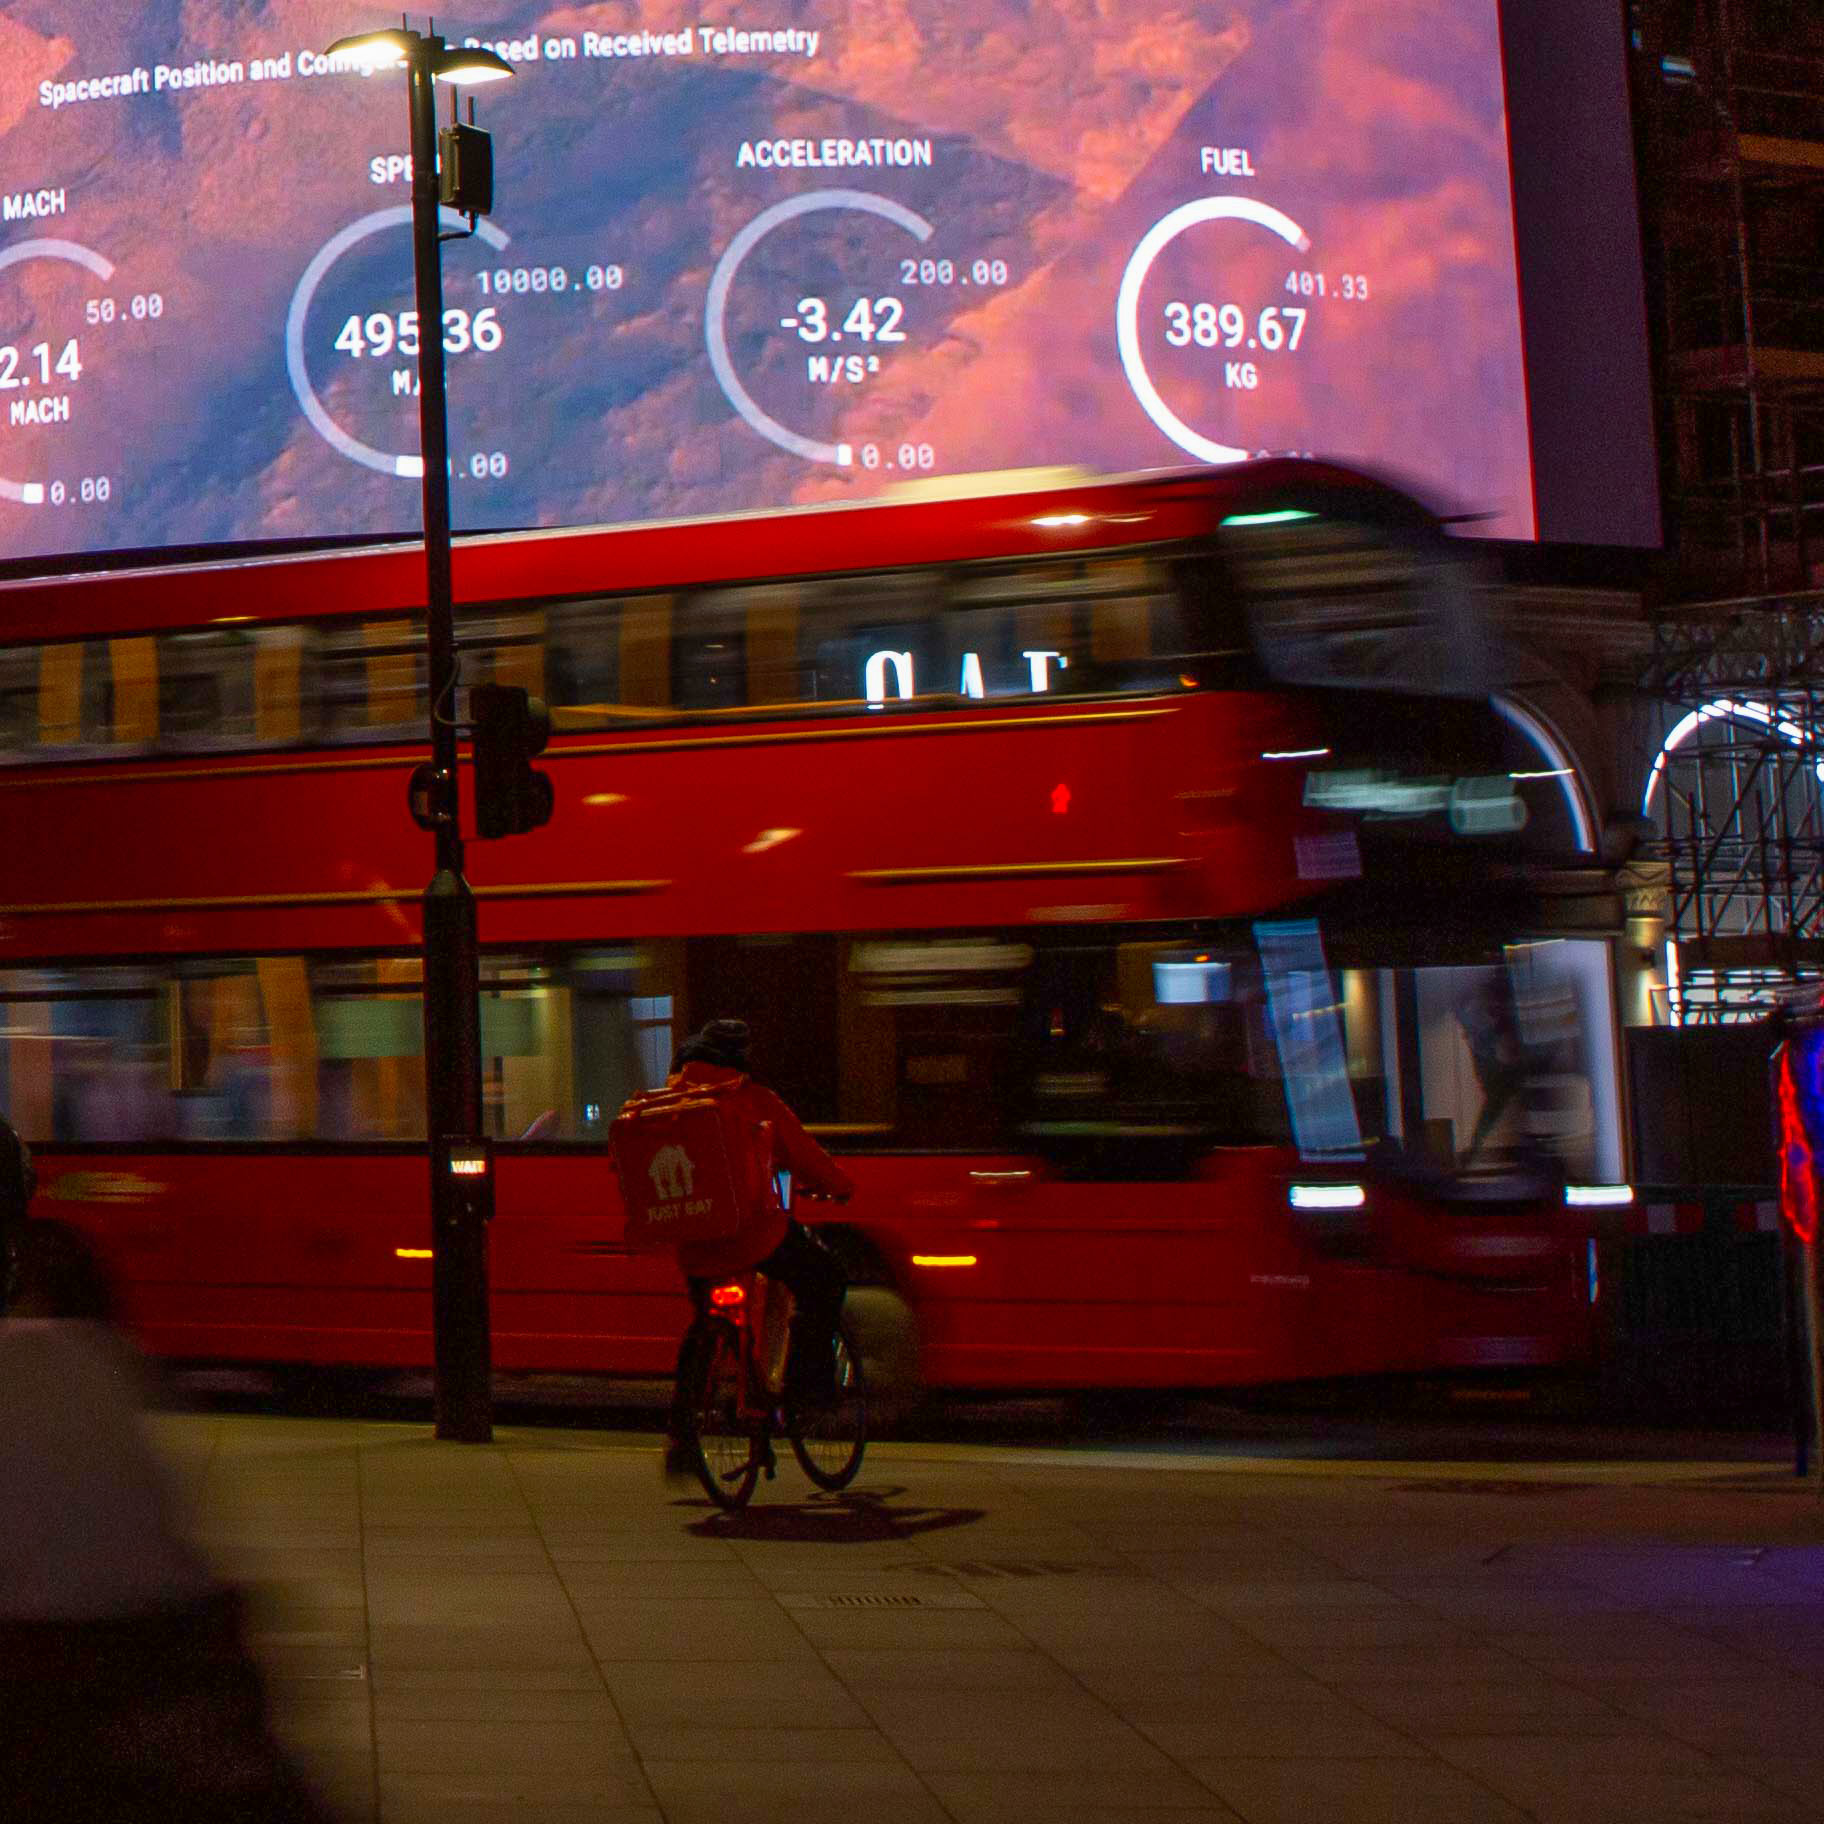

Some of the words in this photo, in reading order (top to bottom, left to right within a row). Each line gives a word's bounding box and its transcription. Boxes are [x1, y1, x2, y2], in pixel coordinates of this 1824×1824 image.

[544, 37, 576, 59] on
[582, 28, 693, 58] Received
[698, 26, 820, 58] Telemetry
[39, 67, 150, 109] Spacecraft
[154, 60, 243, 91] Position
[250, 52, 291, 81] and
[737, 139, 932, 168] ACCELERATION
[1200, 146, 1255, 176] FUEL
[2, 189, 66, 221] MACH
[476, 265, 624, 294] 10000.00
[900, 258, 1009, 286] 200.00
[1285, 271, 1369, 300] 401.33
[85, 293, 164, 325] 50.00
[779, 296, 907, 343] -3.42
[334, 307, 503, 358] 49536
[1164, 302, 1308, 352] 389.67
[1225, 362, 1258, 390] KG
[10, 396, 70, 426] MACH
[861, 443, 935, 470] 0.00
[50, 478, 110, 506] 0.00
[451, 1161, 485, 1174] WAIT
[647, 1205, 679, 1223] JUST
[686, 1199, 713, 1215] EAT
